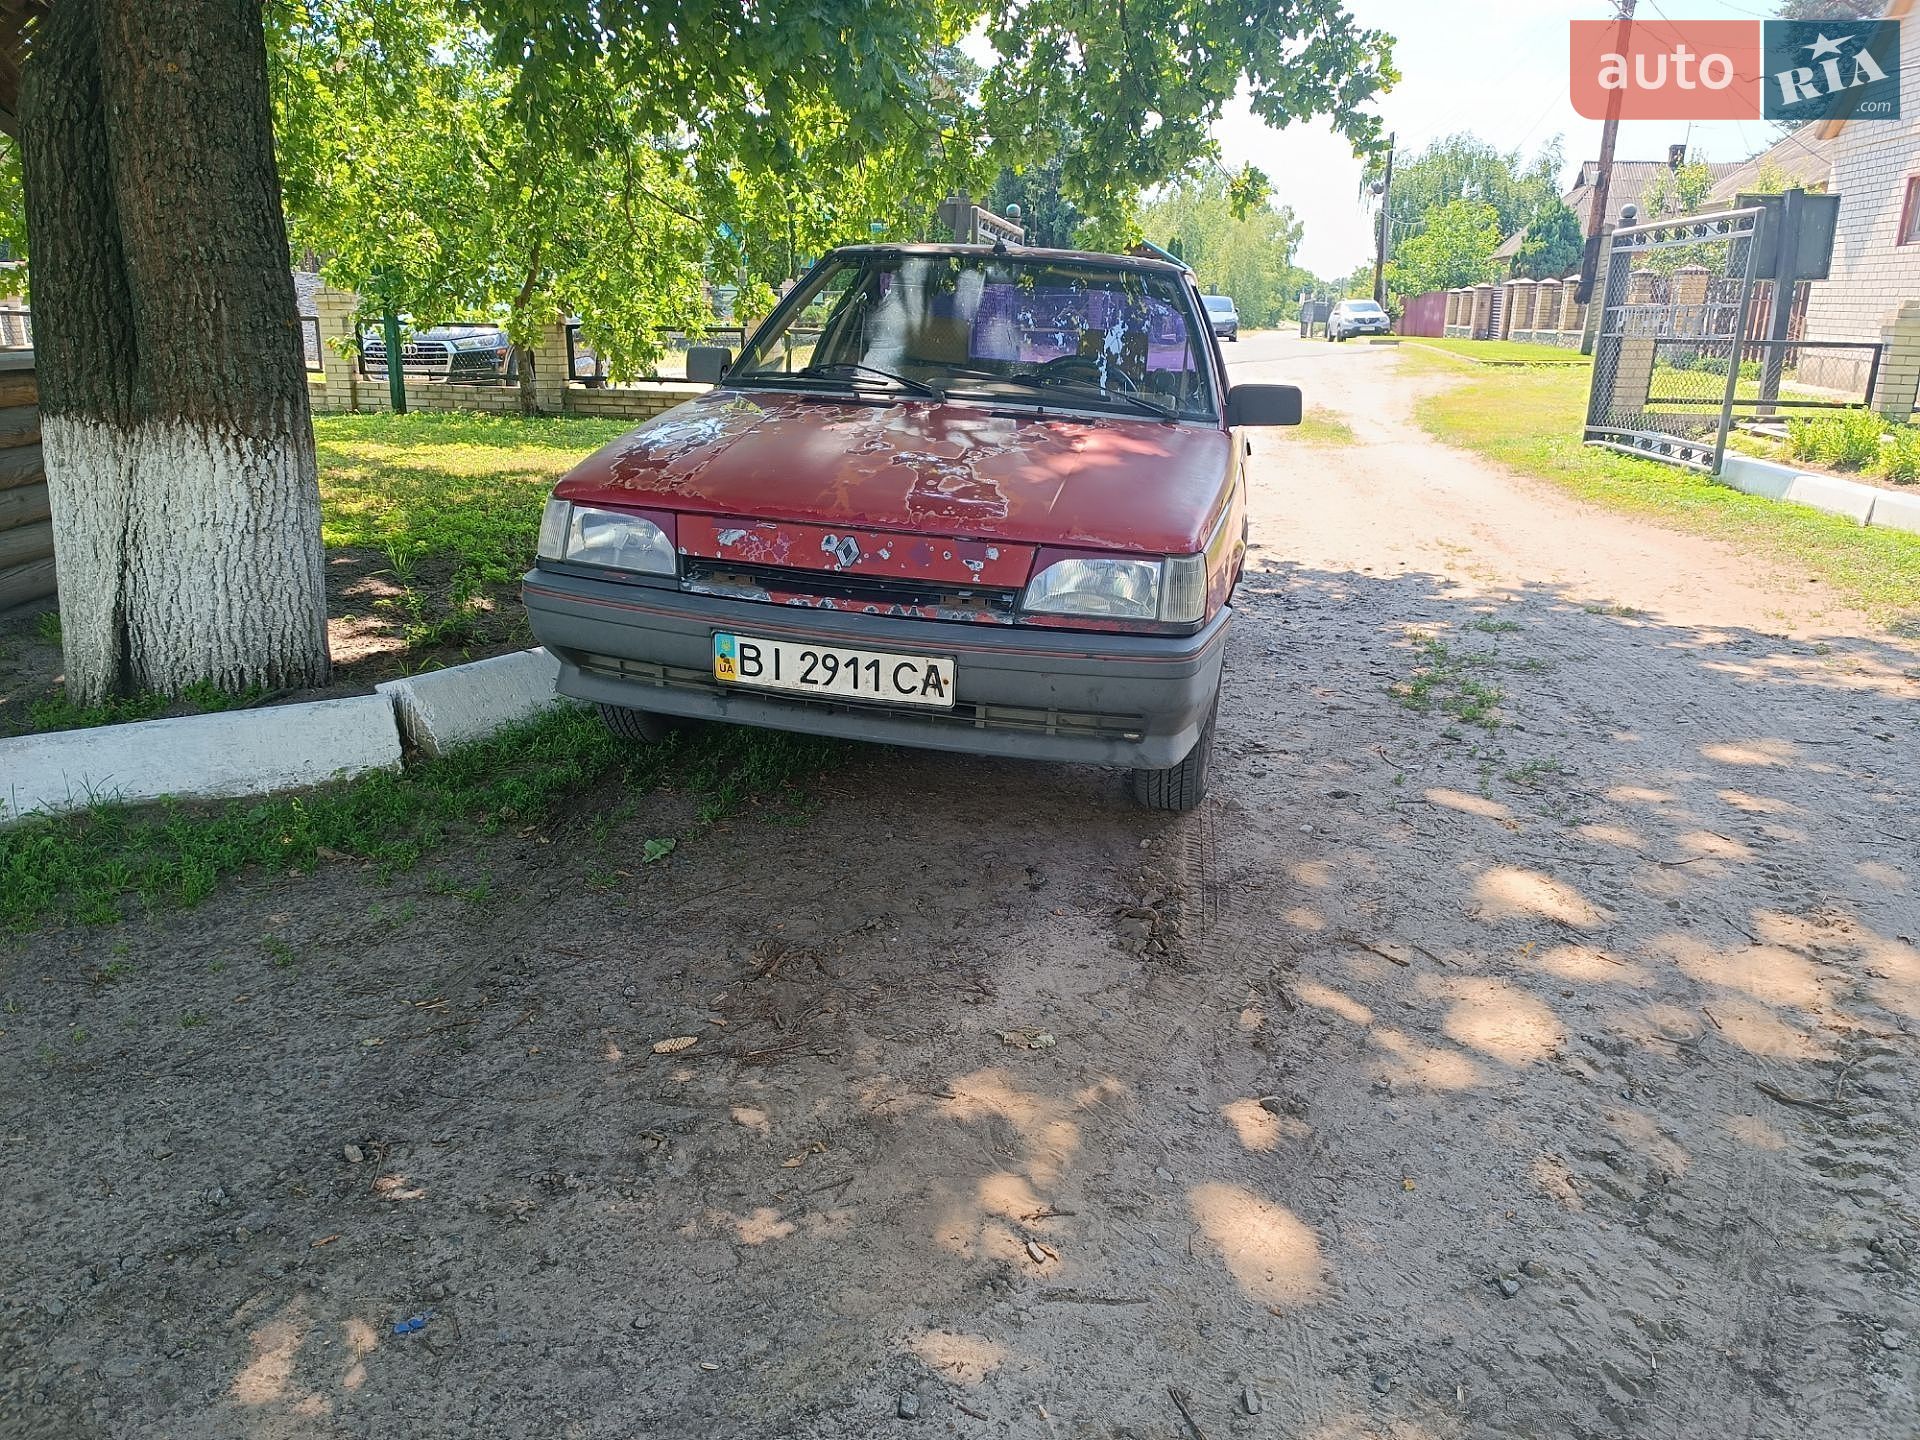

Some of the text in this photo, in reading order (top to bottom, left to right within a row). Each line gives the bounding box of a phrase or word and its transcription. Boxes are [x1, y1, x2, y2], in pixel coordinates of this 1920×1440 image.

[719, 663, 734, 674] UA
[800, 651, 880, 691] 2911
[893, 662, 944, 697] CA
